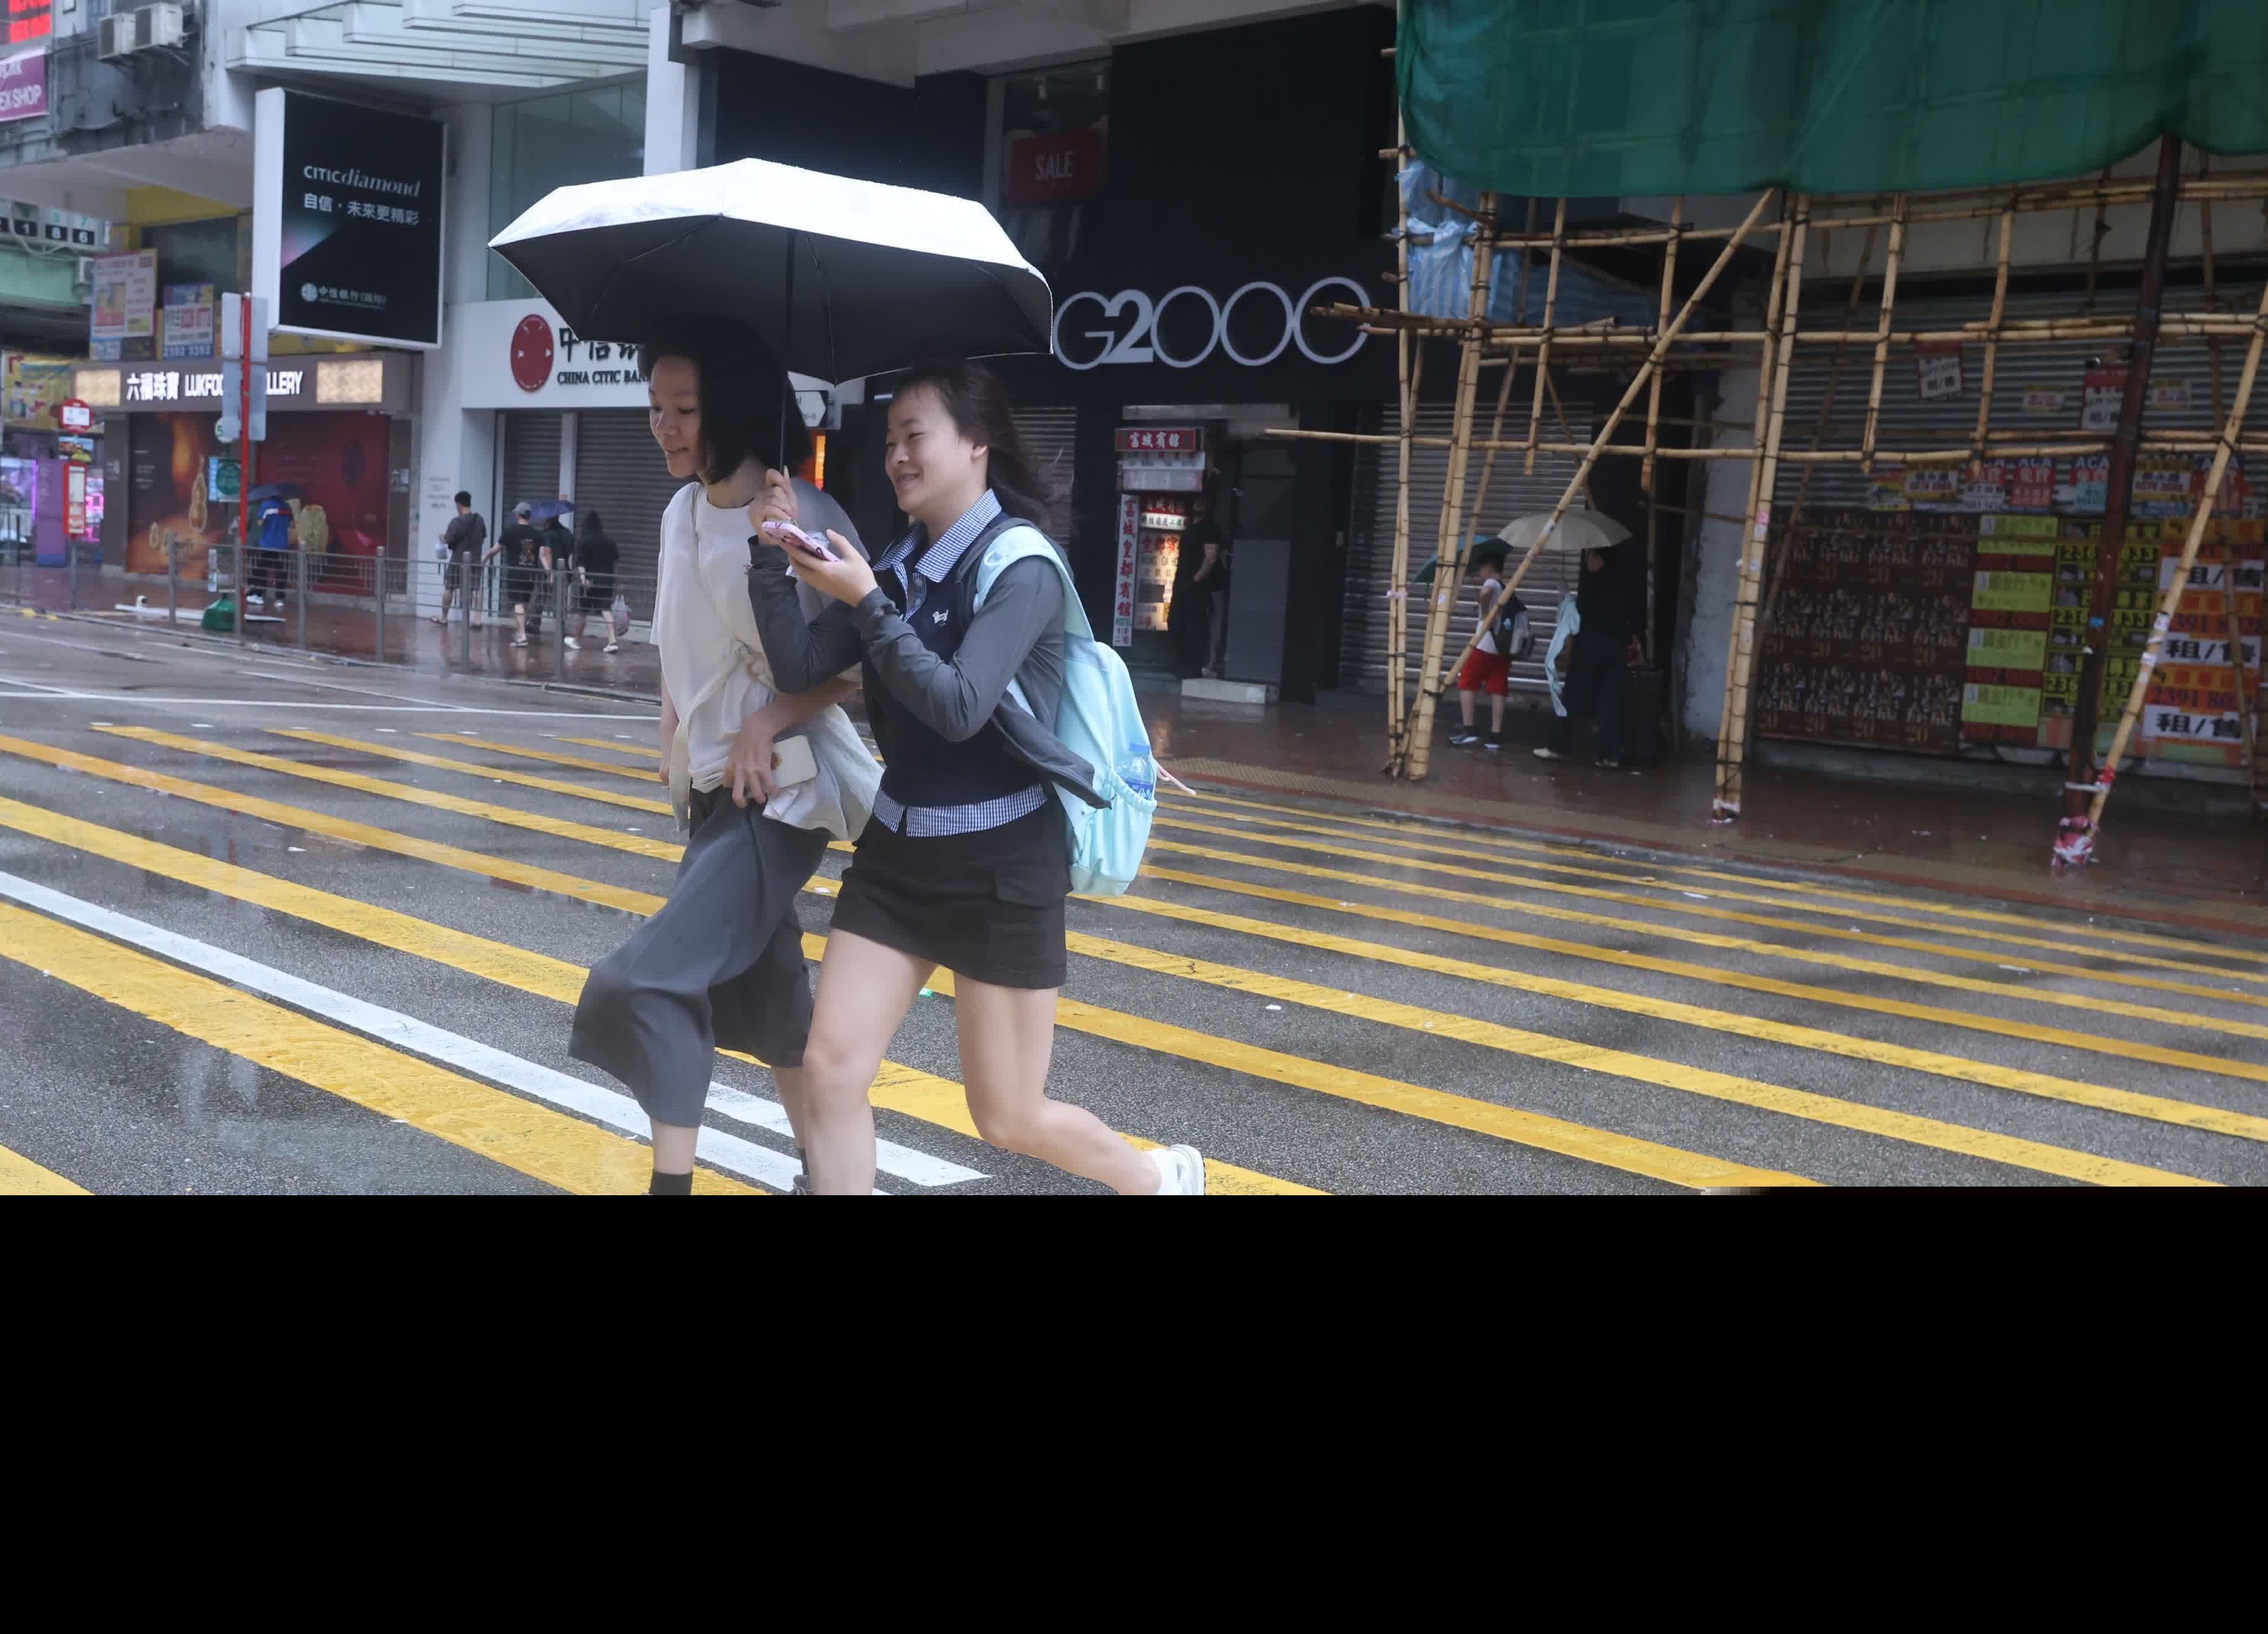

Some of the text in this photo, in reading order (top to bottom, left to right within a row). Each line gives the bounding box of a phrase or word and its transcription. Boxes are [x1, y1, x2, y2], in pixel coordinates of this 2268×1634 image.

[1034, 150, 1073, 182] SALE
[303, 166, 420, 197] CITICdiamond
[78, 231, 89, 243] 6
[1052, 276, 1373, 371] G2000
[127, 371, 179, 400] 六福珠寶
[266, 371, 303, 396] LLERY
[557, 371, 590, 384] CHINA
[592, 371, 621, 383] CITIC
